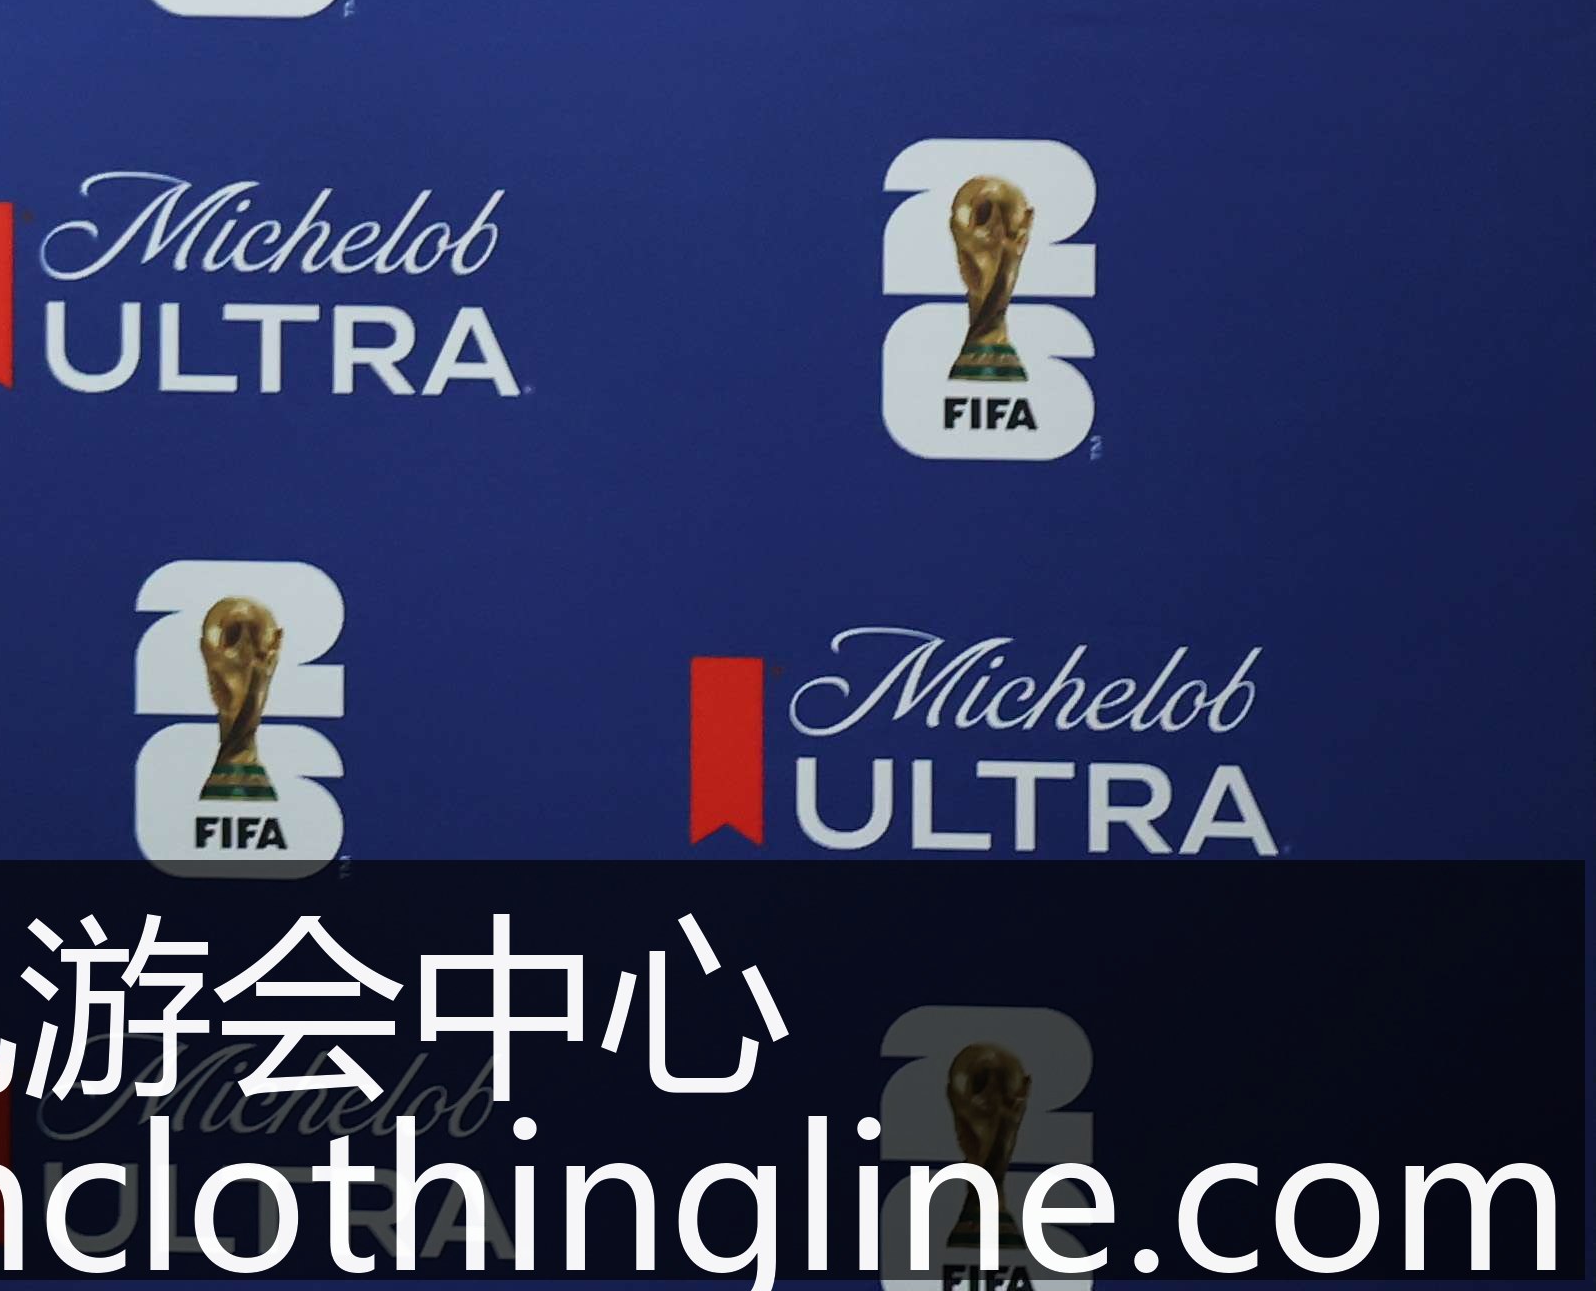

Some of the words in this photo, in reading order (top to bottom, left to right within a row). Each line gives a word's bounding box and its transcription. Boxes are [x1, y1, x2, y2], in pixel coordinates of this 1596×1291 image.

[42, 172, 504, 280] Michelob
[46, 301, 520, 396] ULTRA
[945, 398, 1037, 430] FIFA
[790, 627, 1262, 736] Michelob
[196, 817, 287, 849] FIFA
[796, 757, 1279, 856] ULTRA
